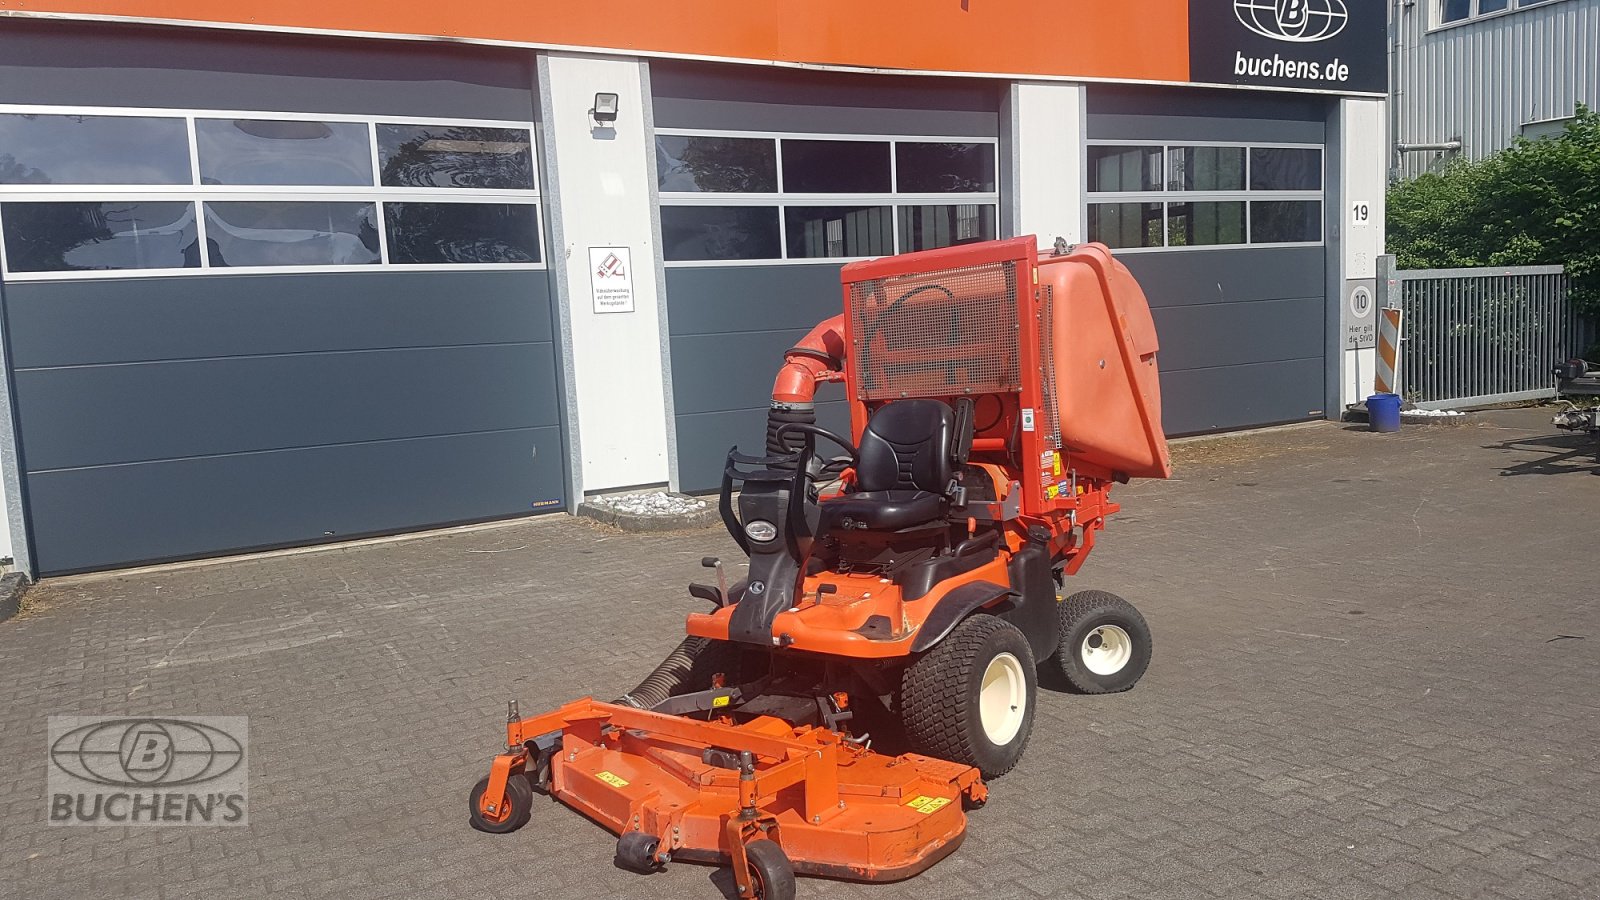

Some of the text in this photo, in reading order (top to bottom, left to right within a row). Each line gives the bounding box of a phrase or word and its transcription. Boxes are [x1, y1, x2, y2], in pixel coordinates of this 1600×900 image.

[1234, 51, 1349, 82] buchens.de
[1353, 204, 1368, 221] 19
[1355, 294, 1367, 310] 10
[1349, 324, 1373, 334] Hier gilt
[1348, 333, 1374, 343] die StVO
